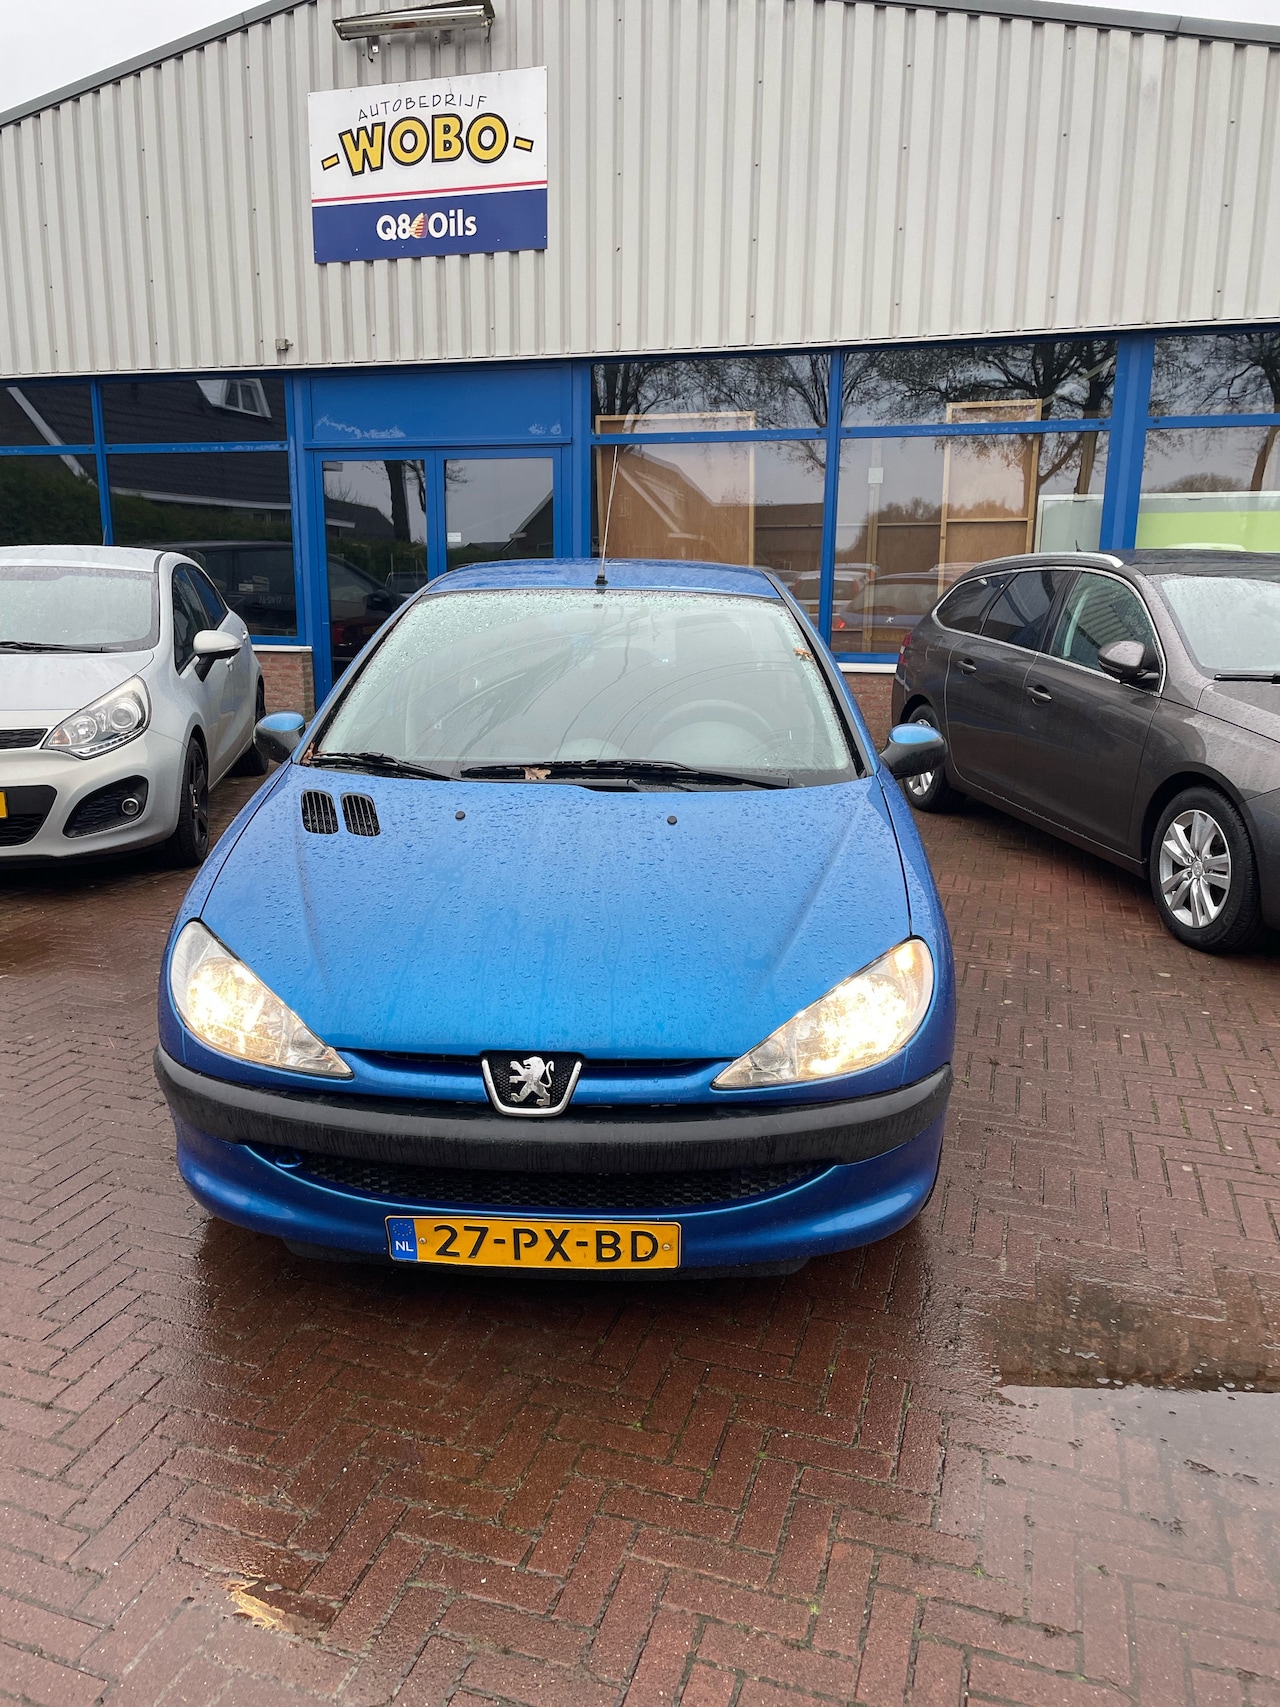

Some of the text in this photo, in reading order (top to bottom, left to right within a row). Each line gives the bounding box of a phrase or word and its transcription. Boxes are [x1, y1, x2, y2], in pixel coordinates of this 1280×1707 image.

[358, 93, 488, 122] AUTOBEDRIJF
[395, 1223, 659, 1263] NL 27-PX-BD
